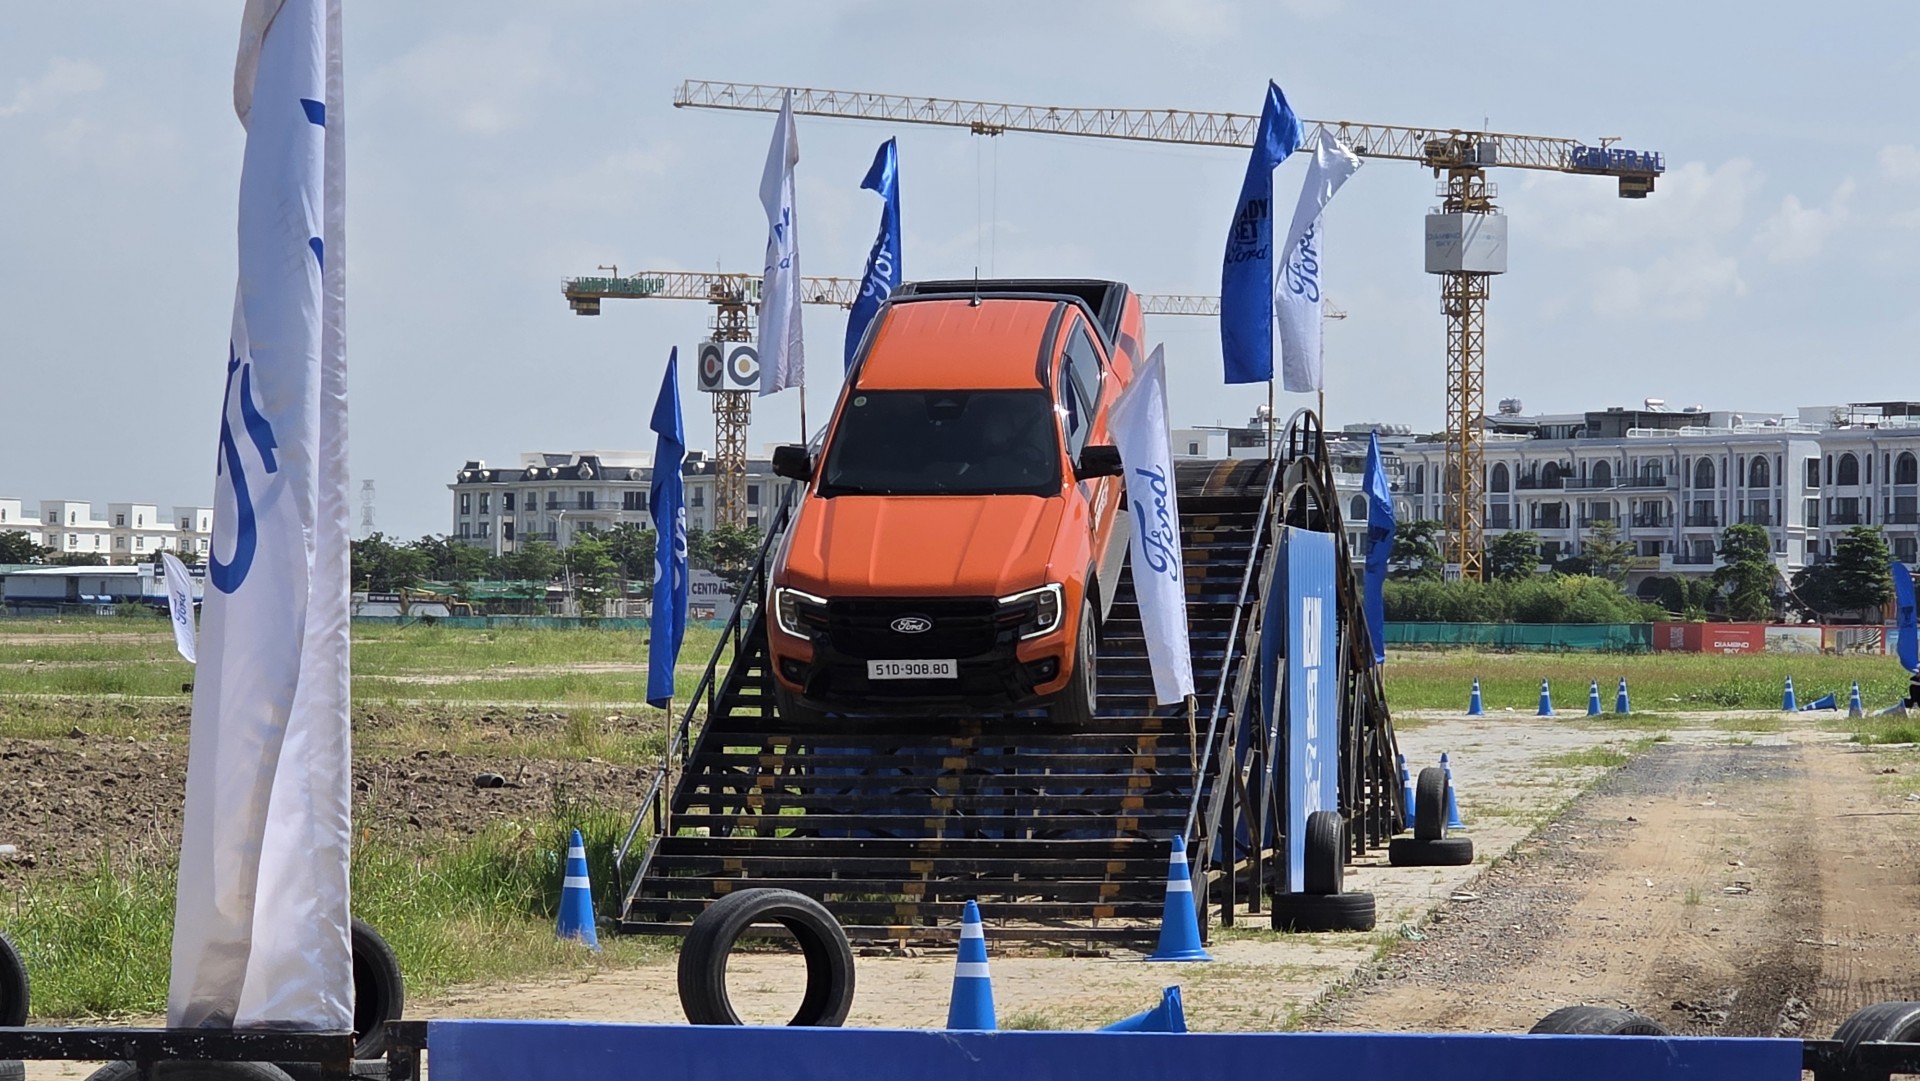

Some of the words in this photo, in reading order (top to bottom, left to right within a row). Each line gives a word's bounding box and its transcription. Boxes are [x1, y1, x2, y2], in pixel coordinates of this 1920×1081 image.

[1572, 146, 1666, 172] CENTRAL
[1239, 199, 1268, 219] ADY
[1134, 464, 1177, 582] Ford
[174, 590, 186, 625] Ford
[896, 618, 925, 632] Ford
[875, 663, 949, 676] 51D-908.80
